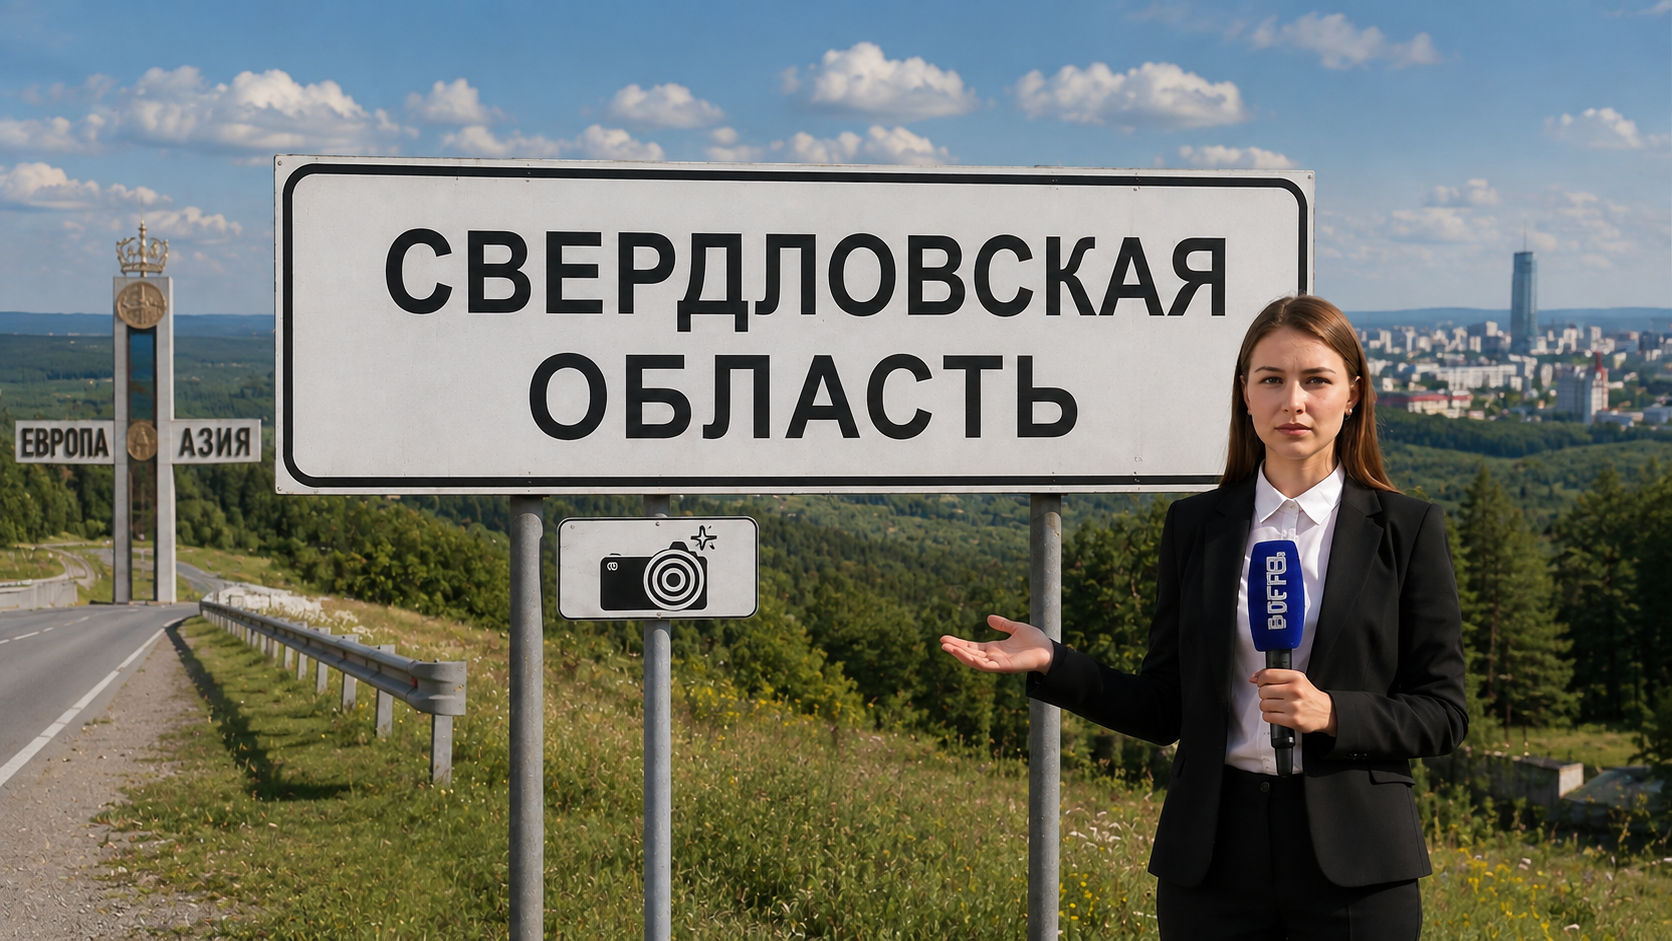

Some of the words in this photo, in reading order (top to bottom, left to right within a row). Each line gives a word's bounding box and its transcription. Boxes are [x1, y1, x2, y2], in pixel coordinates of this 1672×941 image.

[385, 227, 1227, 333] СВЕРДЛОВСКАЯ
[529, 352, 1079, 441] ОБЛАСТЬ
[21, 428, 109, 458] ЕВРОПА
[178, 426, 251, 458] АЗИЯ
